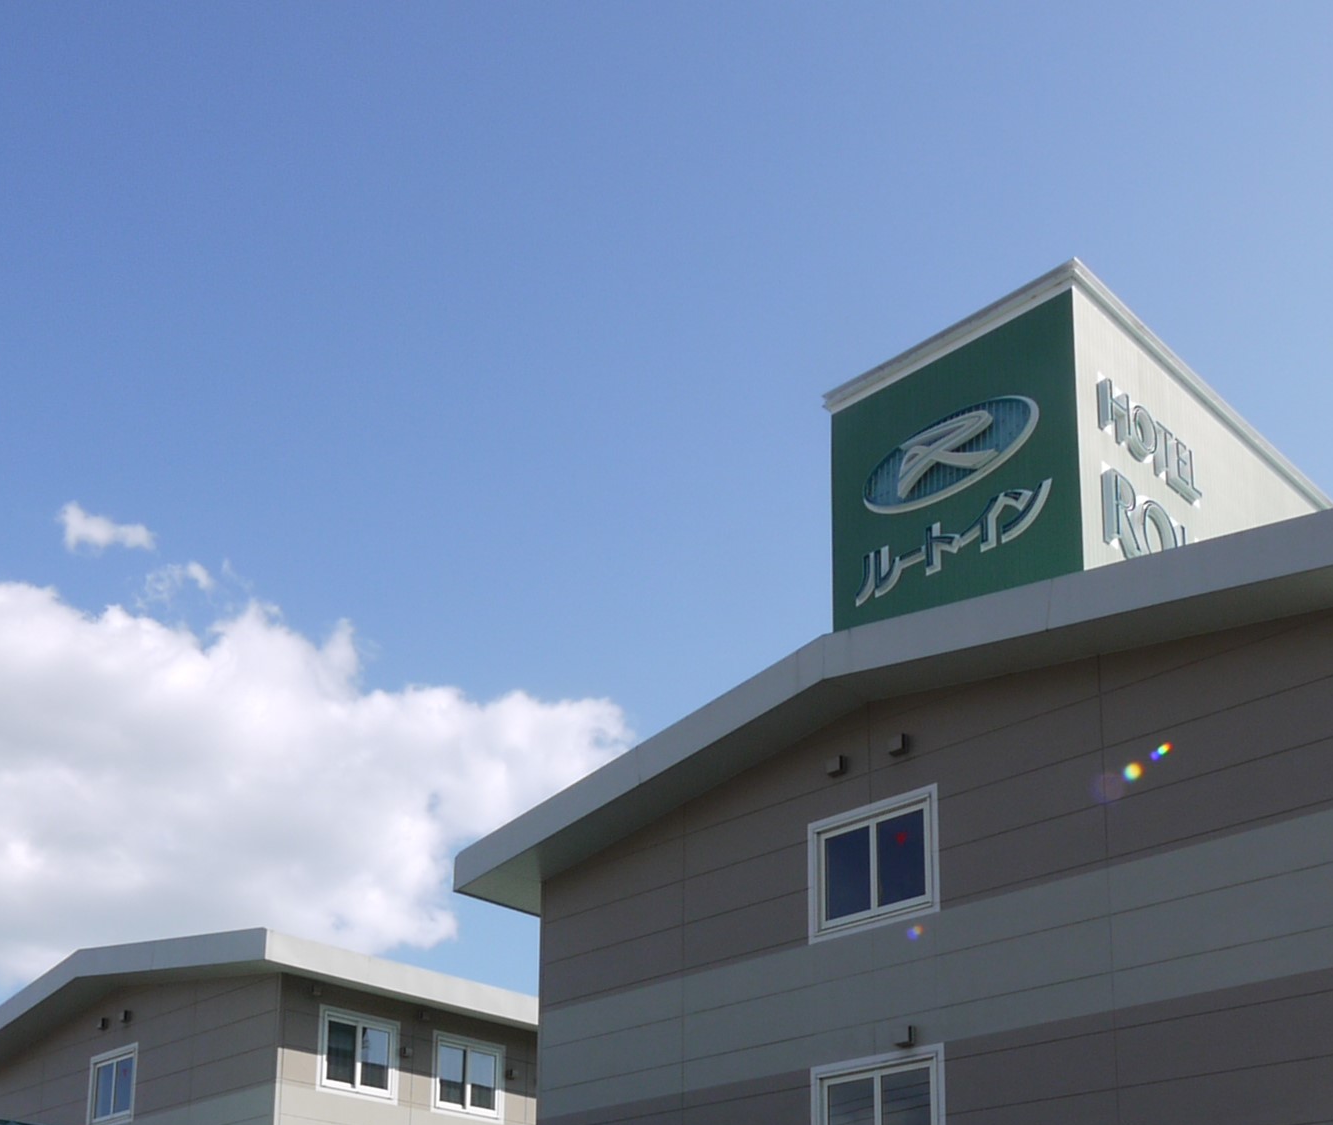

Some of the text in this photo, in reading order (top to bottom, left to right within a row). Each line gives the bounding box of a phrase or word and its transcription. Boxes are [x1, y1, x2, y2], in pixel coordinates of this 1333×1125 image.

[1095, 376, 1203, 508] HOTEL
[855, 477, 1053, 608] ルートイン
[1100, 467, 1187, 560] RO
